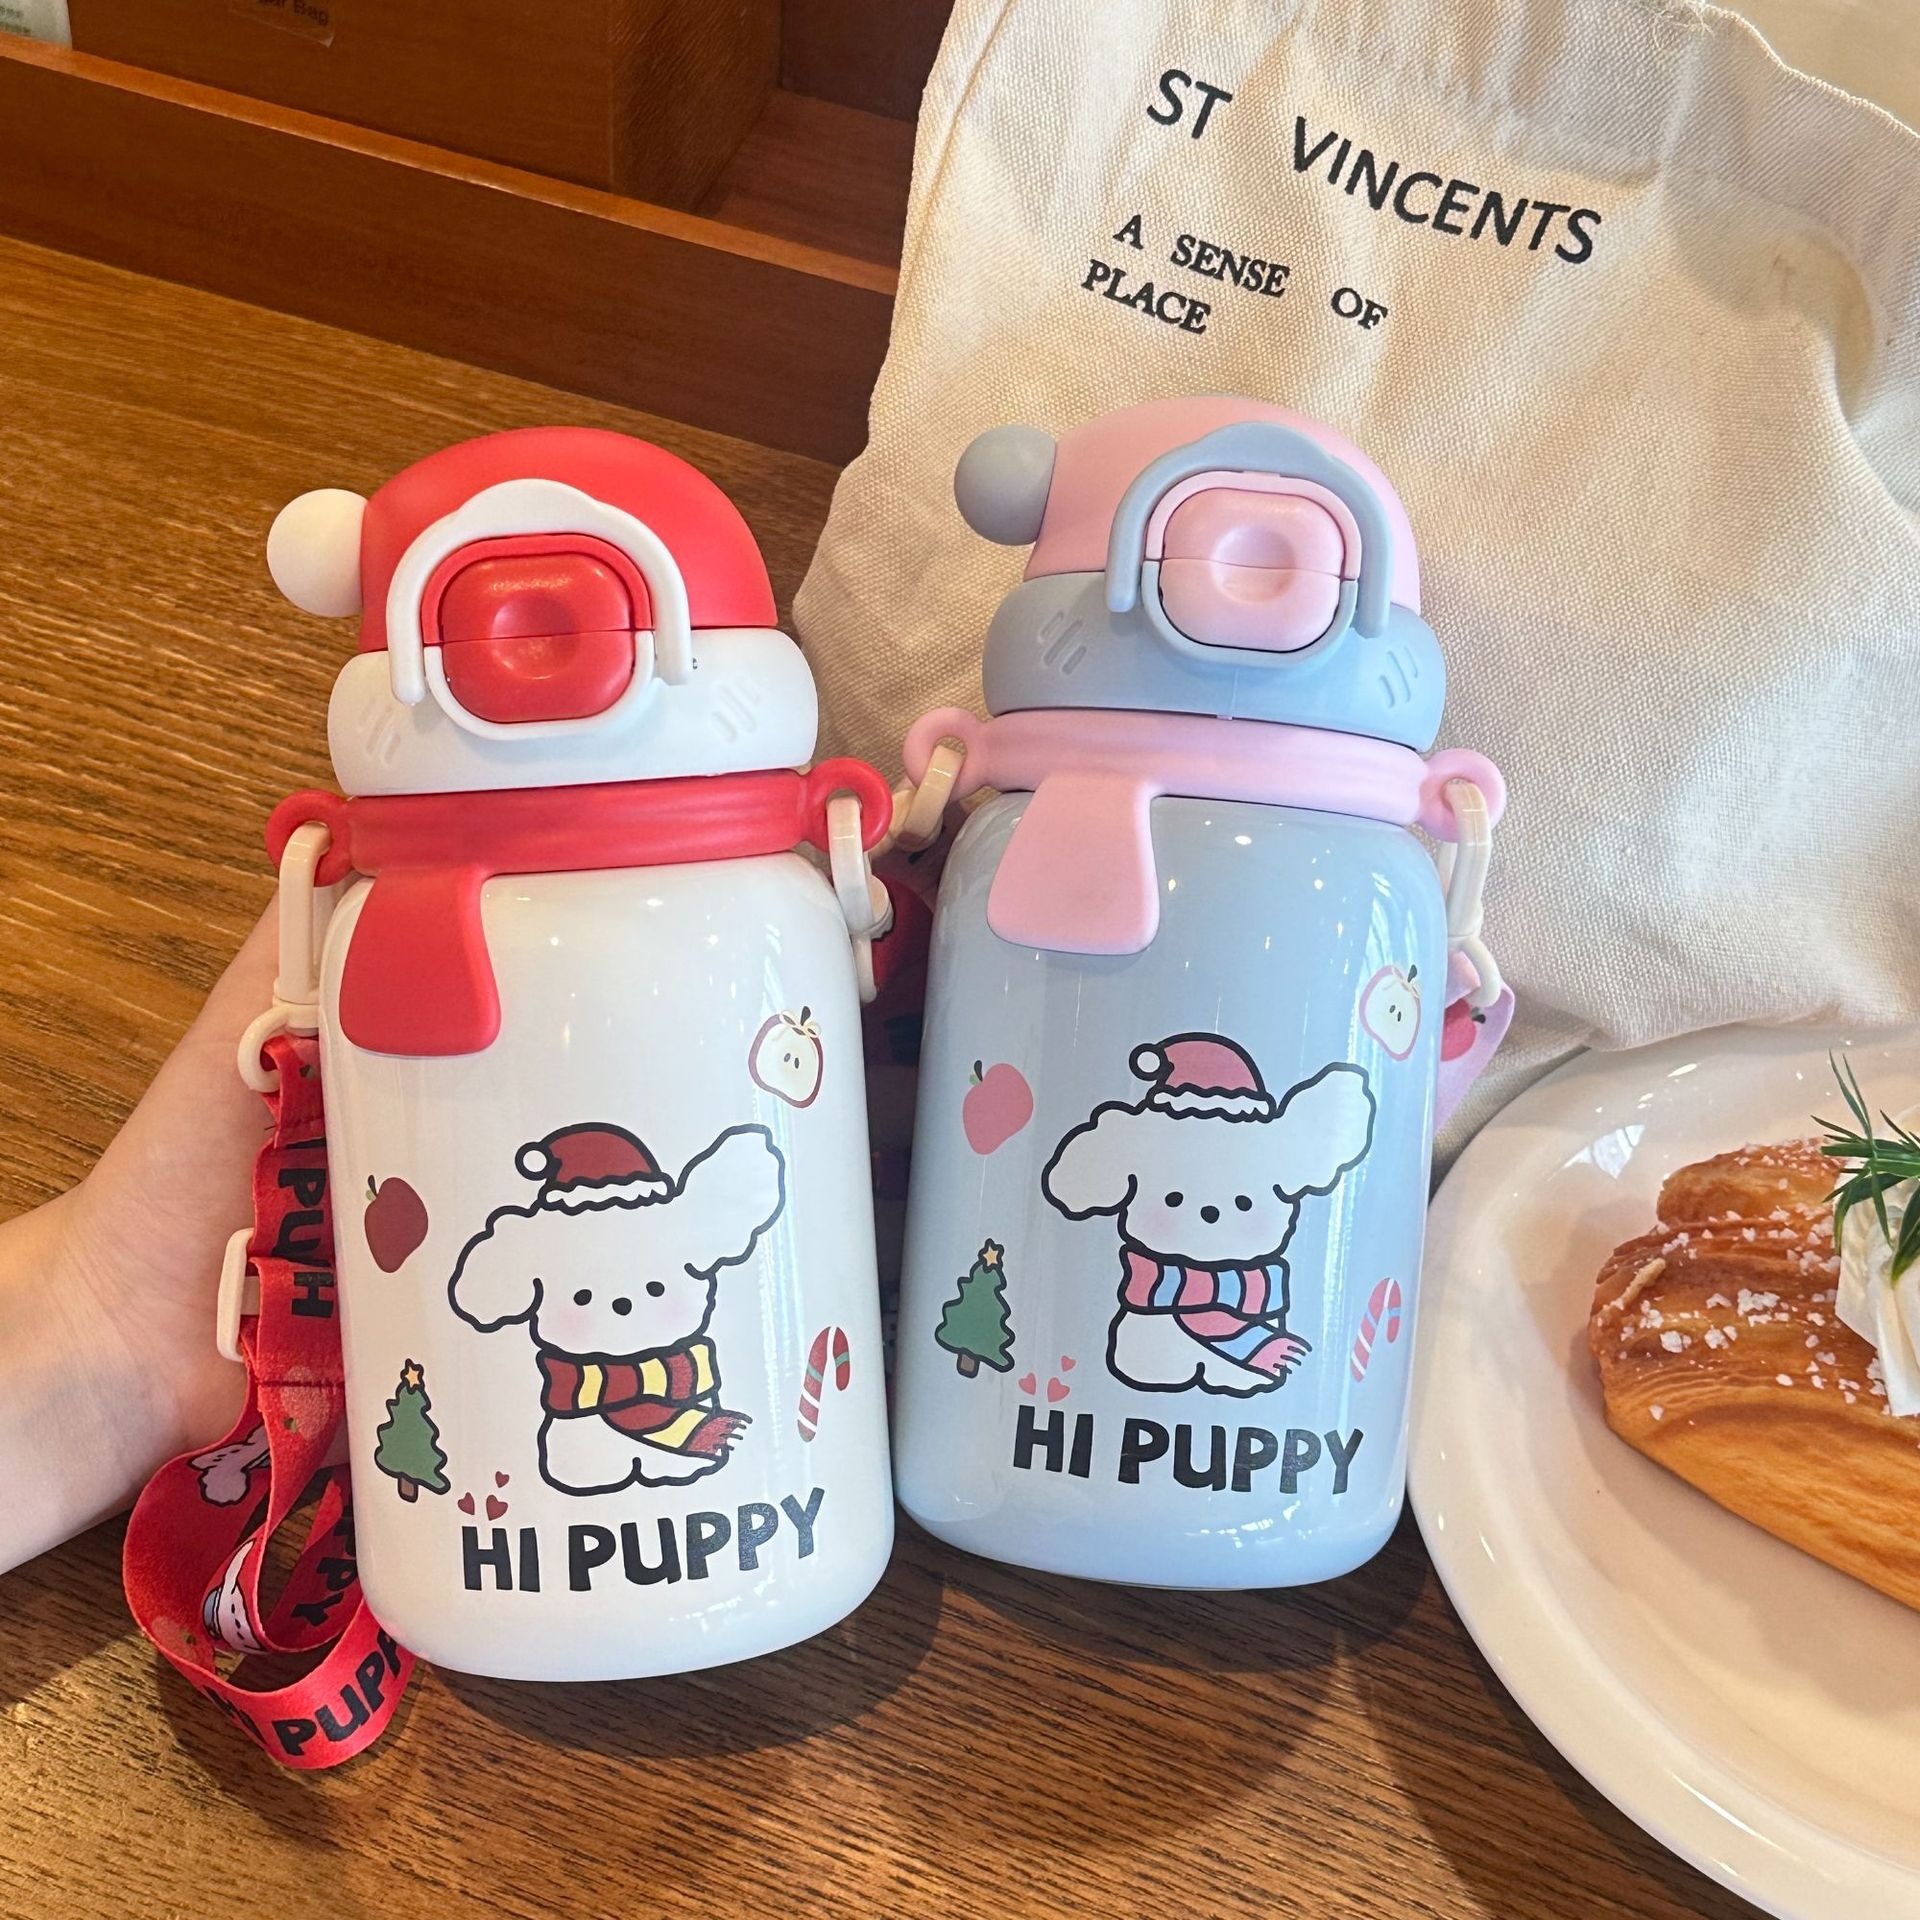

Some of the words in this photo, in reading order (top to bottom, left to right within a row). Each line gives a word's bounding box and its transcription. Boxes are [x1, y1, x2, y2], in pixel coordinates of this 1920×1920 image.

[1147, 69, 1232, 139] ST
[1293, 115, 1602, 264] VINCENTS
[1081, 259, 1211, 335] PLACE
[1113, 214, 1145, 250] A
[1170, 234, 1290, 298] SENSE
[1330, 287, 1388, 330] OF
[1013, 1404, 1093, 1479] HI
[1117, 1417, 1364, 1495] PUPPY
[462, 1525, 540, 1593] HI
[567, 1486, 826, 1592] PUPPY
